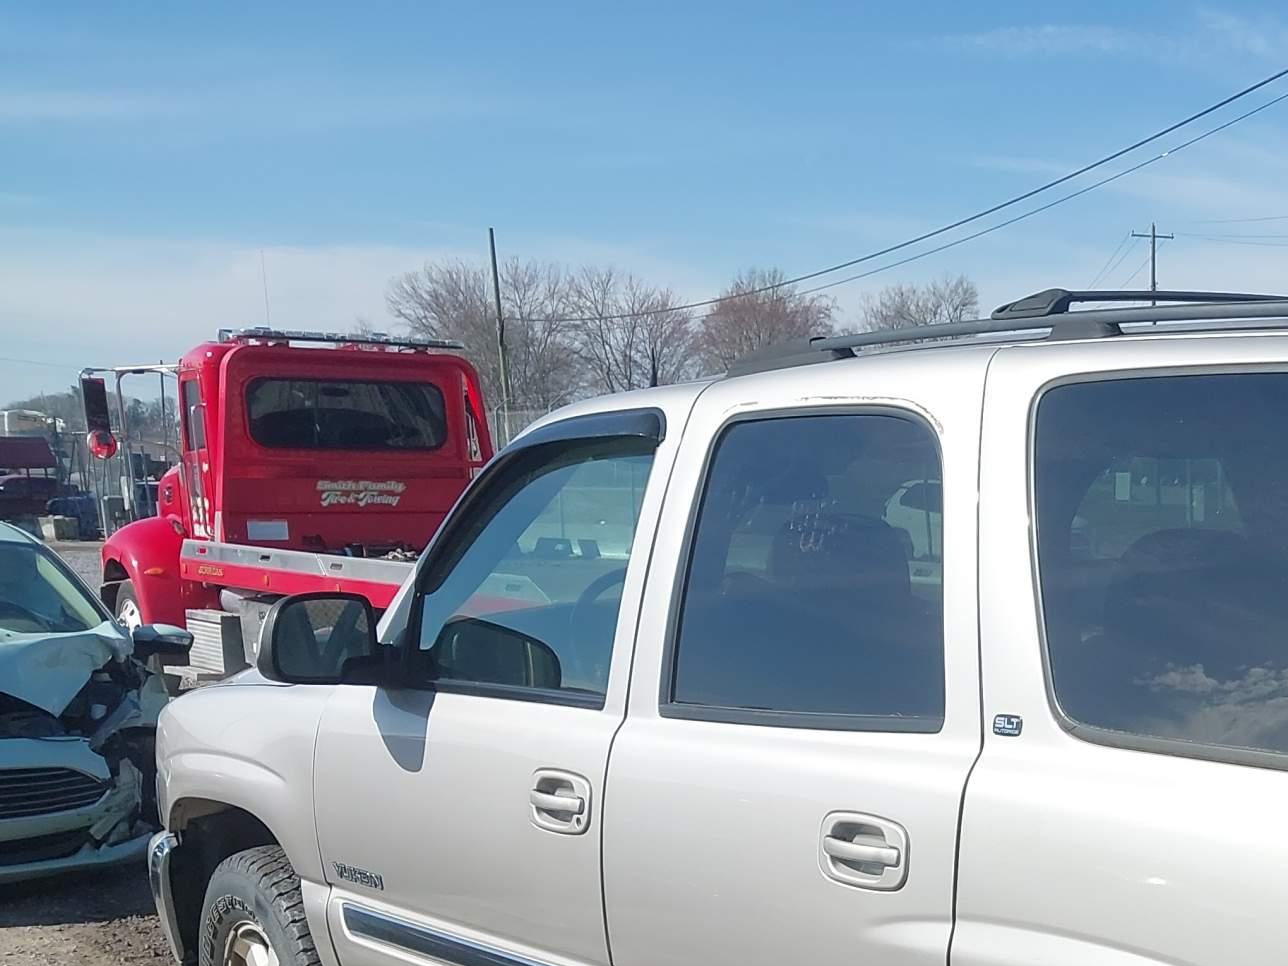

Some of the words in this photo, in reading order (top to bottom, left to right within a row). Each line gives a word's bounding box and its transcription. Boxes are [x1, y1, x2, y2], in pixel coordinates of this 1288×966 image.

[356, 491, 401, 507] Towing
[994, 716, 1021, 729] SLT
[331, 861, 384, 891] YUKON
